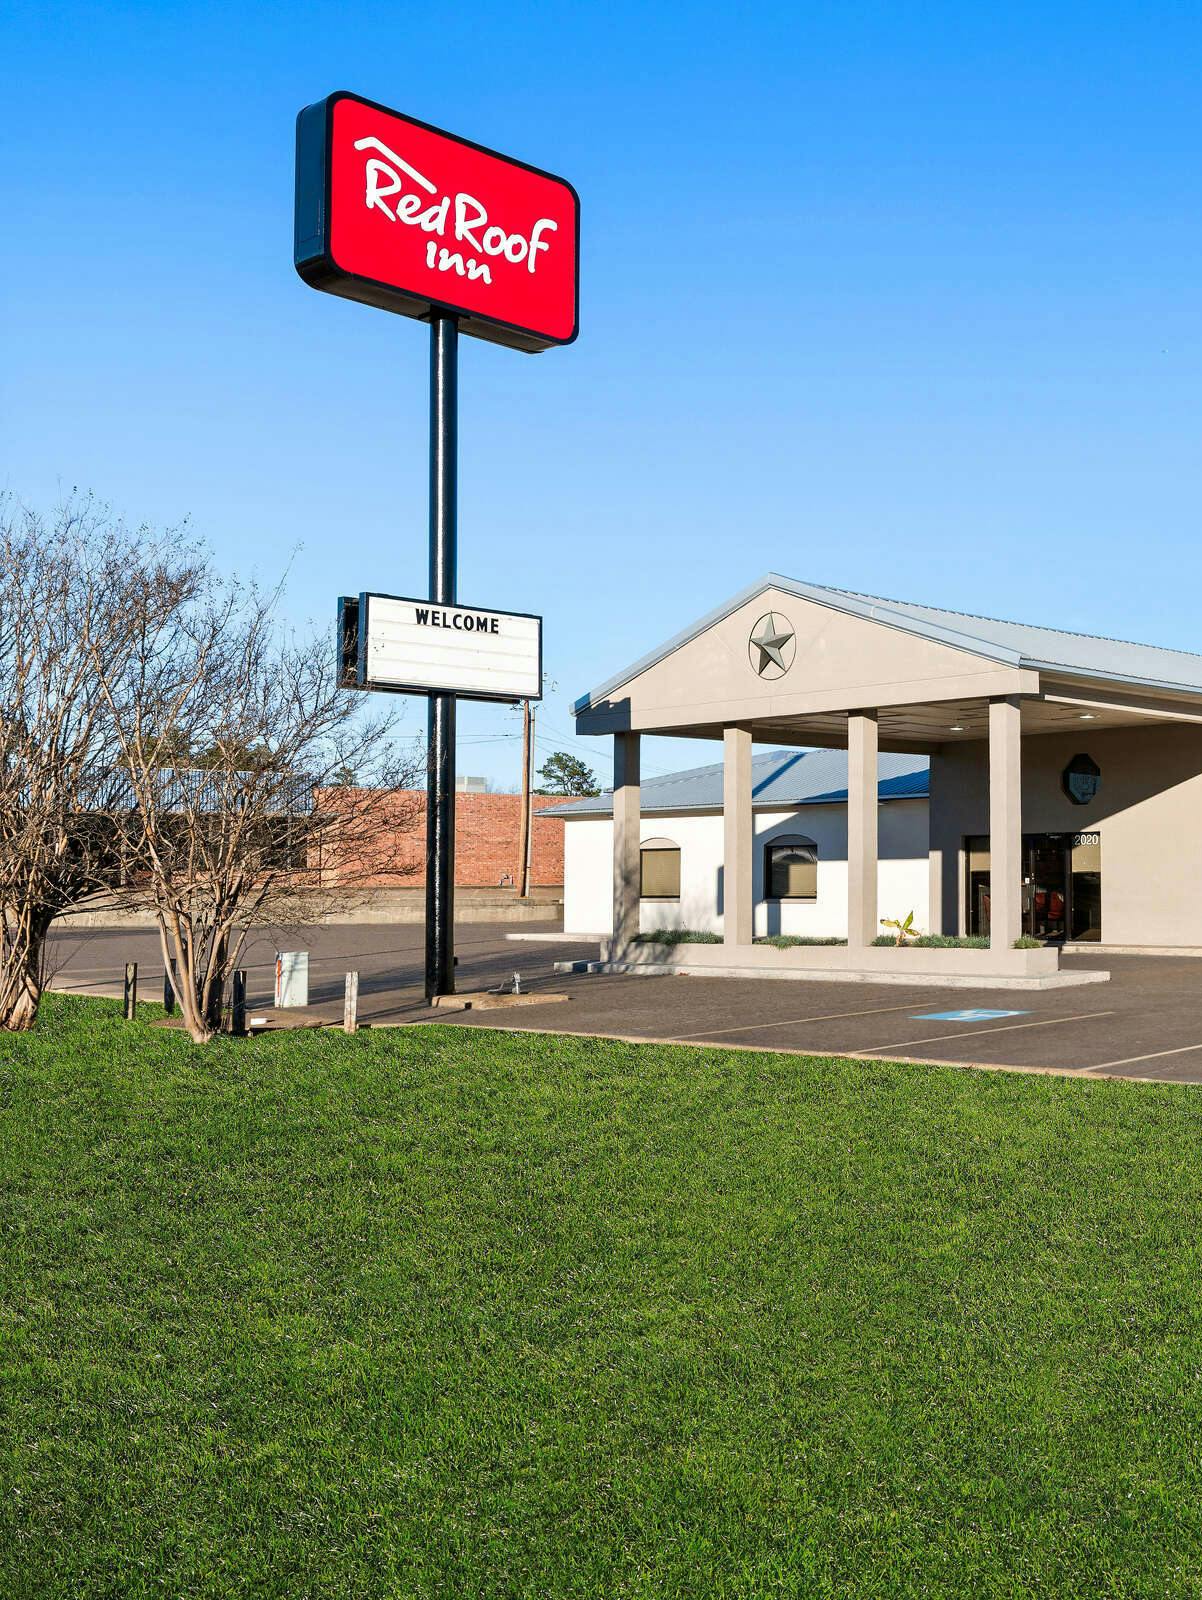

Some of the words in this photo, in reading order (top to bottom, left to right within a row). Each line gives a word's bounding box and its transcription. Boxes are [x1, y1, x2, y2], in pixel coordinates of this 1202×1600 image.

[365, 158, 451, 236] Red
[454, 192, 558, 274] Roof
[426, 240, 493, 285] Inn
[415, 608, 499, 634] WELCOME
[1074, 834, 1098, 845] 2020
